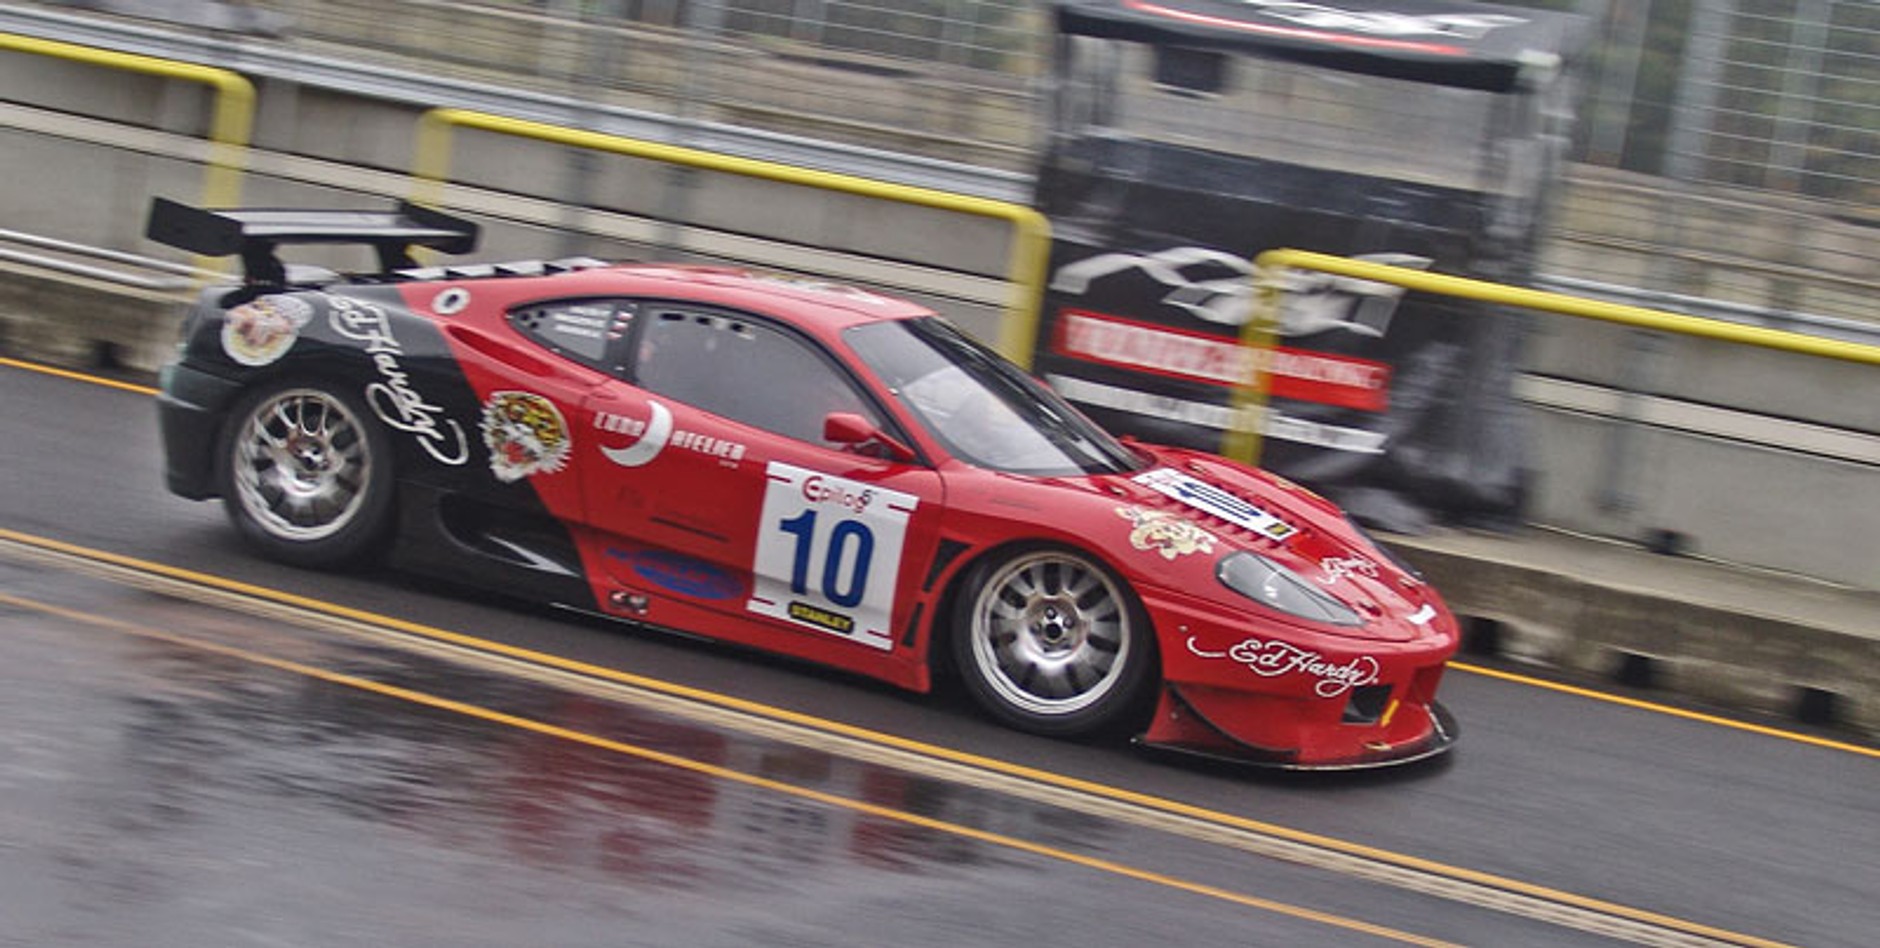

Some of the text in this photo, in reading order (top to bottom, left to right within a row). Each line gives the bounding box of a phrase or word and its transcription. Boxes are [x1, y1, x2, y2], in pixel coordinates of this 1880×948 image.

[342, 306, 470, 465] Hardy
[670, 430, 746, 460] ATELIER
[802, 475, 864, 513] Epilog
[779, 508, 875, 608] 10
[792, 604, 850, 630] STANLEY
[1229, 638, 1380, 698] Ed Hardy
